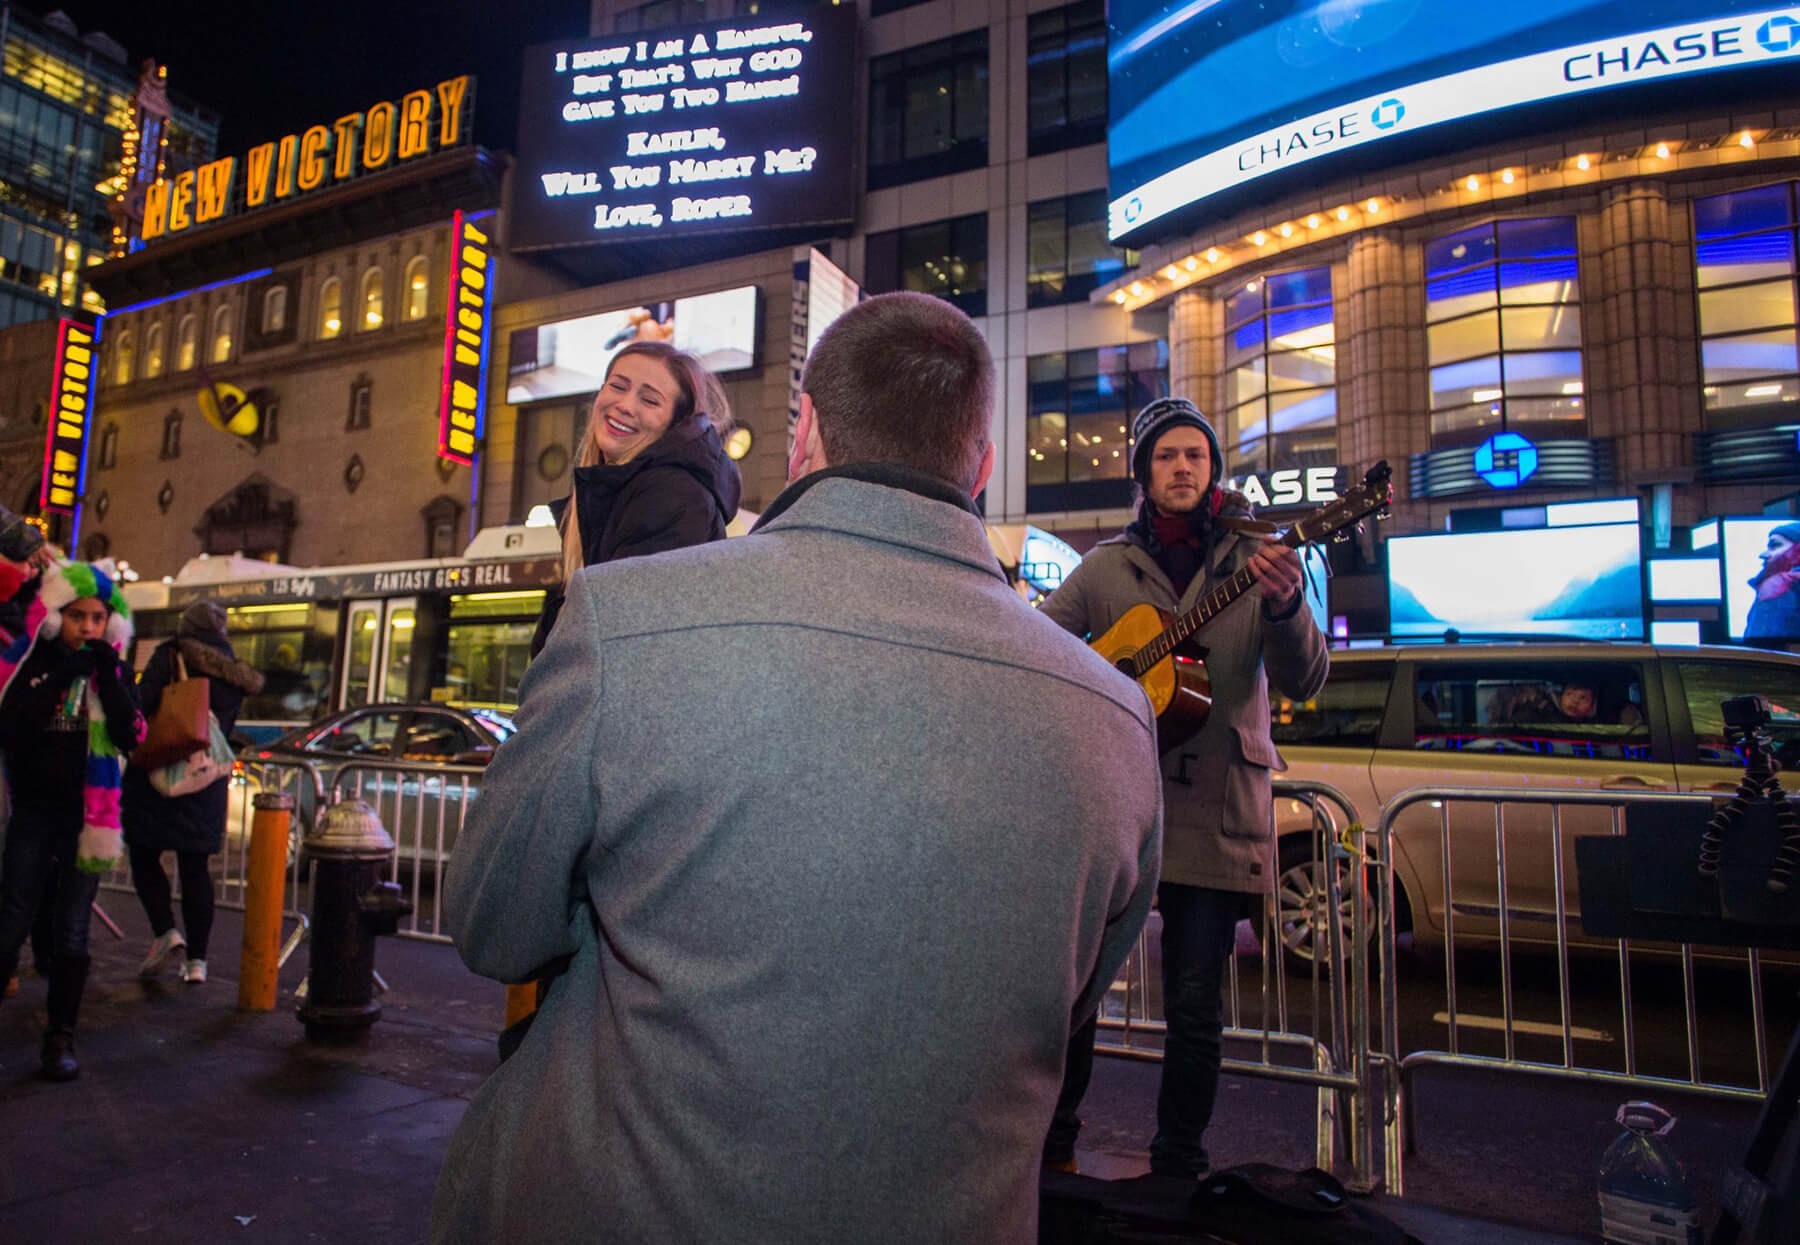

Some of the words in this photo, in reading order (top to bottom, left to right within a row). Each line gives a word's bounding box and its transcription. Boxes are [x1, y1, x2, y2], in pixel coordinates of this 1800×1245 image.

[555, 51, 569, 72] I
[572, 46, 632, 70] KNOW
[636, 41, 650, 61] I
[653, 39, 686, 59] AM
[689, 33, 711, 54] A
[573, 74, 615, 95] BUT
[618, 63, 687, 89] THAT'S
[691, 57, 745, 80] WHY
[749, 47, 804, 73] GOD
[1563, 26, 1744, 82] CHASE
[563, 99, 617, 122] GAVE
[621, 93, 666, 115] YOU
[670, 87, 721, 109] TWO
[142, 156, 235, 240] NEW
[246, 75, 470, 207] VICTORY
[1238, 112, 1361, 171] CHASE
[541, 171, 603, 197] WILL
[610, 165, 663, 190] YOU
[669, 155, 758, 185] MARRY
[764, 146, 818, 175] ME?
[594, 203, 665, 230] LOVE,
[455, 222, 488, 366] VICTORY
[57, 327, 92, 440] VICTORY
[449, 379, 478, 455] NEW
[50, 449, 78, 506] NEW
[1229, 466, 1338, 507] ASE
[374, 569, 432, 593] FANTASY
[435, 567, 470, 589] GETS
[474, 564, 511, 586] REAL
